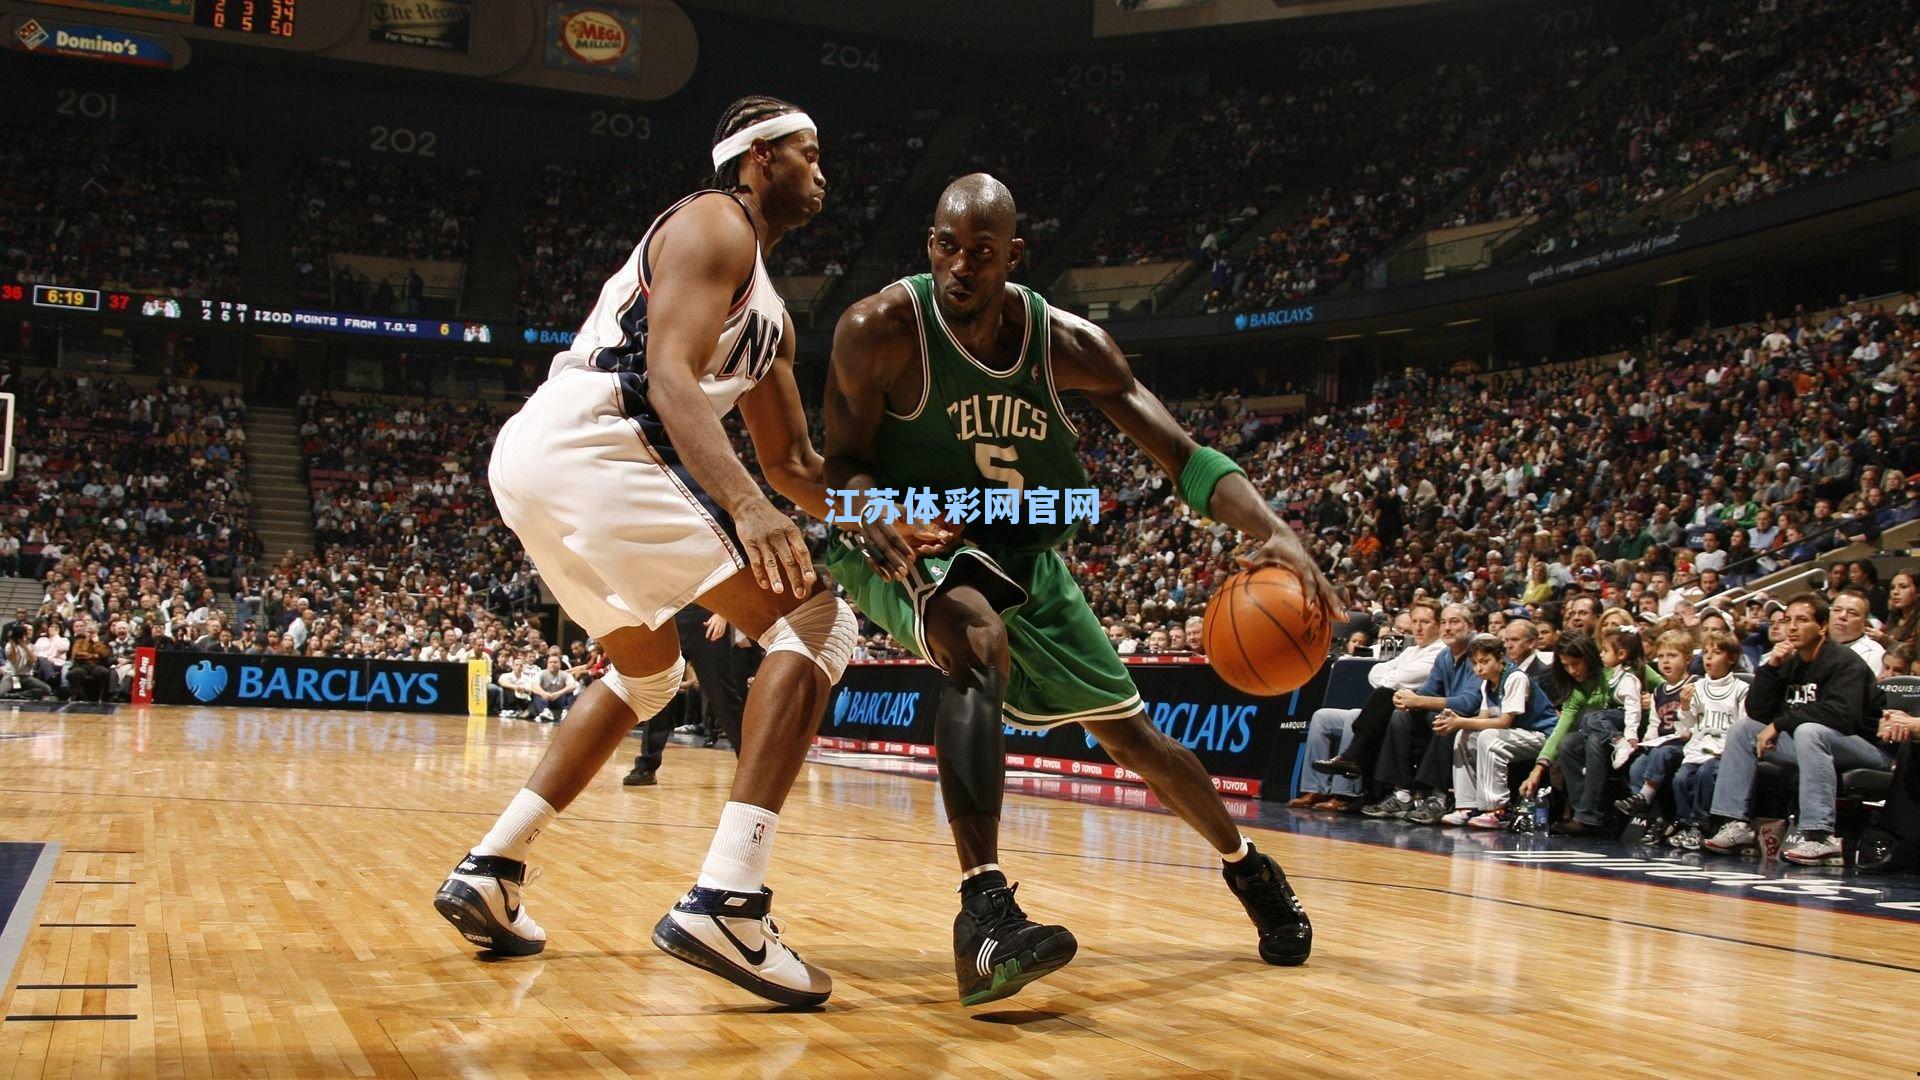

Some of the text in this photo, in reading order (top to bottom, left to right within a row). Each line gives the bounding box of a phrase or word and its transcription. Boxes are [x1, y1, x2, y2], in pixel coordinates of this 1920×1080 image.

[579, 21, 621, 41] MEGA
[56, 30, 138, 55] Domino's
[821, 42, 880, 72] 204
[1067, 62, 1125, 87] 205
[56, 89, 117, 119] 201
[590, 110, 651, 140] 203
[370, 125, 437, 157] 202
[47, 290, 84, 306] 6:19
[109, 294, 130, 310] 37
[202, 308, 211, 320] 2
[238, 312, 245, 323] 1
[254, 310, 293, 324] IZOD
[295, 313, 338, 326] POINTS
[344, 318, 377, 330] FROM
[440, 323, 450, 336] 6
[1250, 306, 1314, 328] BARCLAYS
[239, 665, 439, 705] BARCLAYS
[1877, 684, 1914, 693] ARQUIS
[847, 692, 919, 727] BARCLAYS
[1280, 721, 1307, 730] MARQUIS
[1042, 759, 1061, 770] TOYOTA
[1081, 764, 1102, 775] TOYOTA
[1222, 778, 1248, 792] TOYOTA
